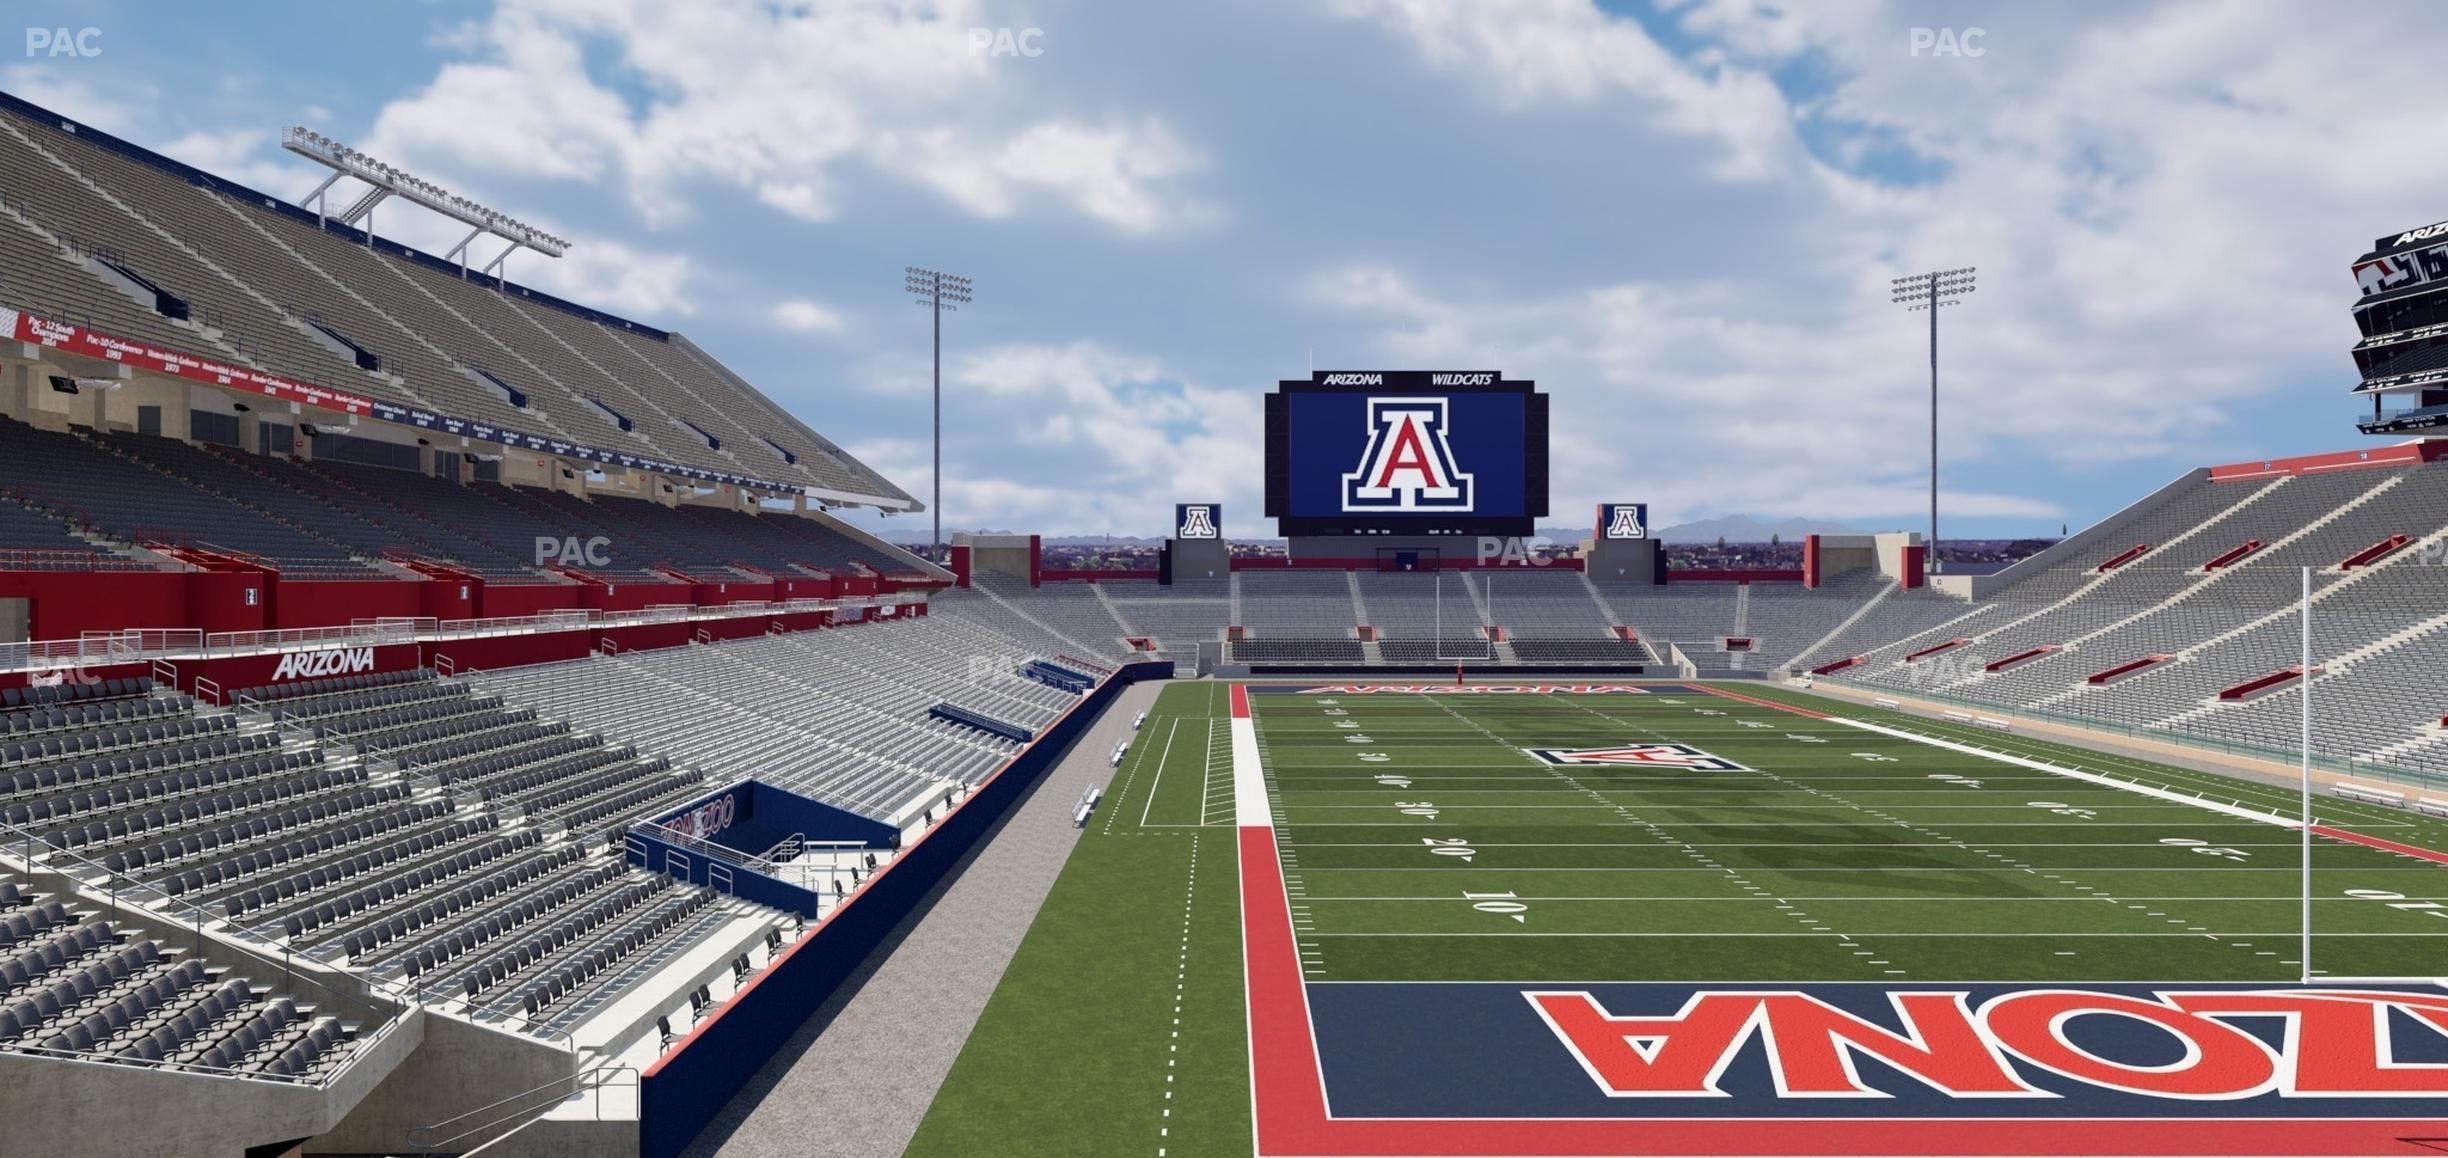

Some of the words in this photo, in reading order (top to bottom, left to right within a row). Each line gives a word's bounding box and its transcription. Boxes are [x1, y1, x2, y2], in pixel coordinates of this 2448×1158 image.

[1323, 373, 1383, 386] ARIZONA
[1432, 373, 1492, 386] WILDCATS
[1342, 397, 1474, 512] A
[272, 647, 374, 681] ARIZONA
[1394, 802, 1439, 815] 30
[1422, 838, 1476, 856] 20
[2159, 838, 2252, 857] 20
[1463, 890, 1528, 913] 10
